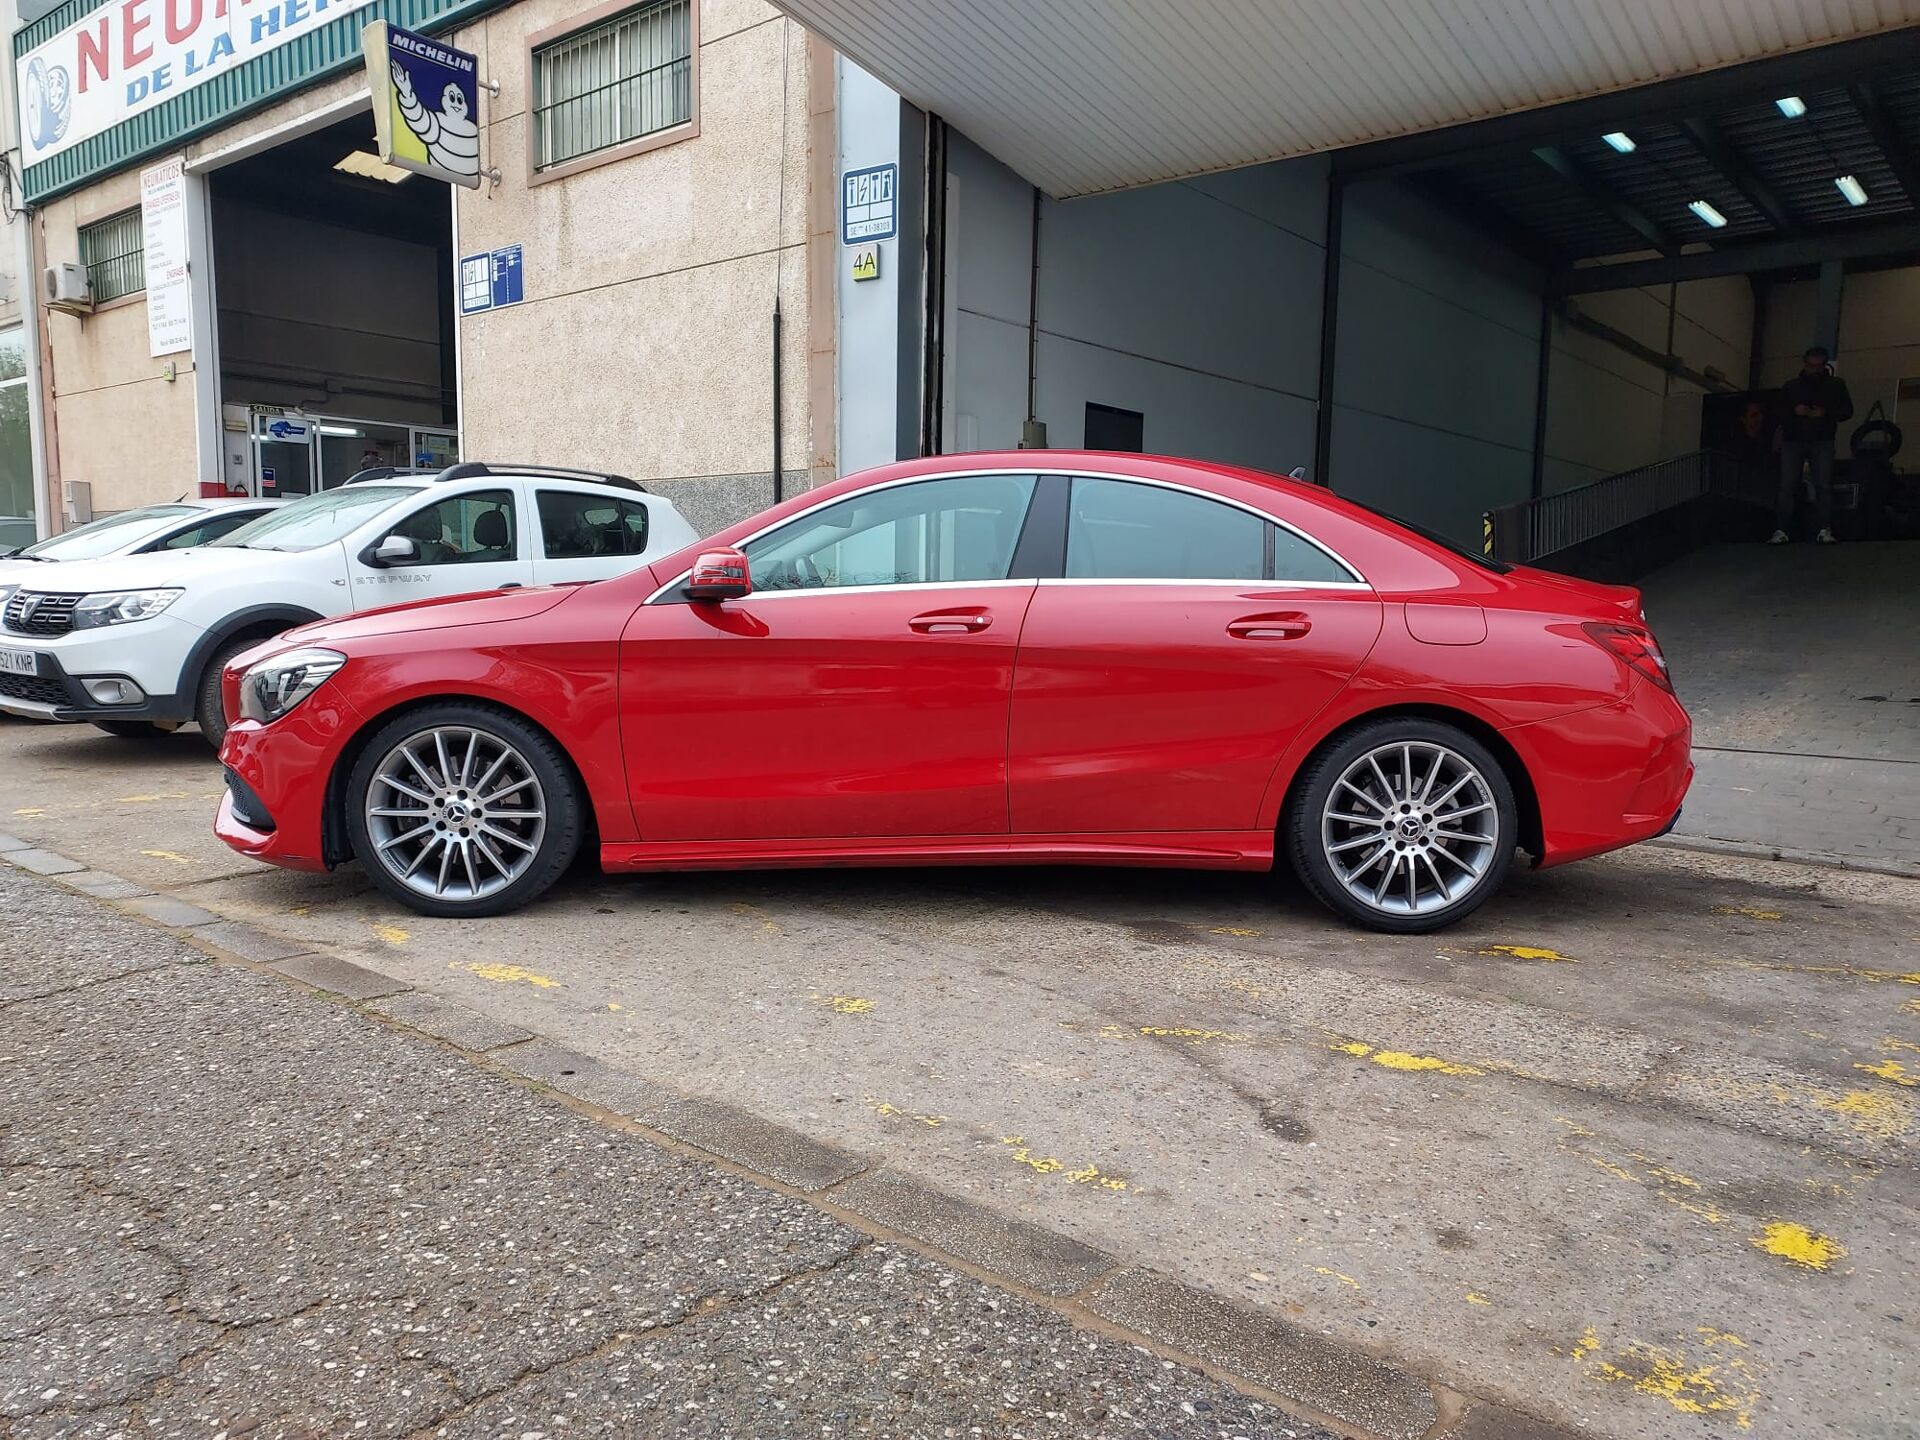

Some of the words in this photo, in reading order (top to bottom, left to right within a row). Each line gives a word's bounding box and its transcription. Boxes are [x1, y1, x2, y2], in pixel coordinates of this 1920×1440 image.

[392, 33, 473, 72] MICHELIN
[126, 62, 172, 107] DE
[184, 31, 236, 77] LA
[853, 252, 876, 271] 4A
[355, 574, 432, 585] STEPWAY
[15, 653, 34, 672] KNR
